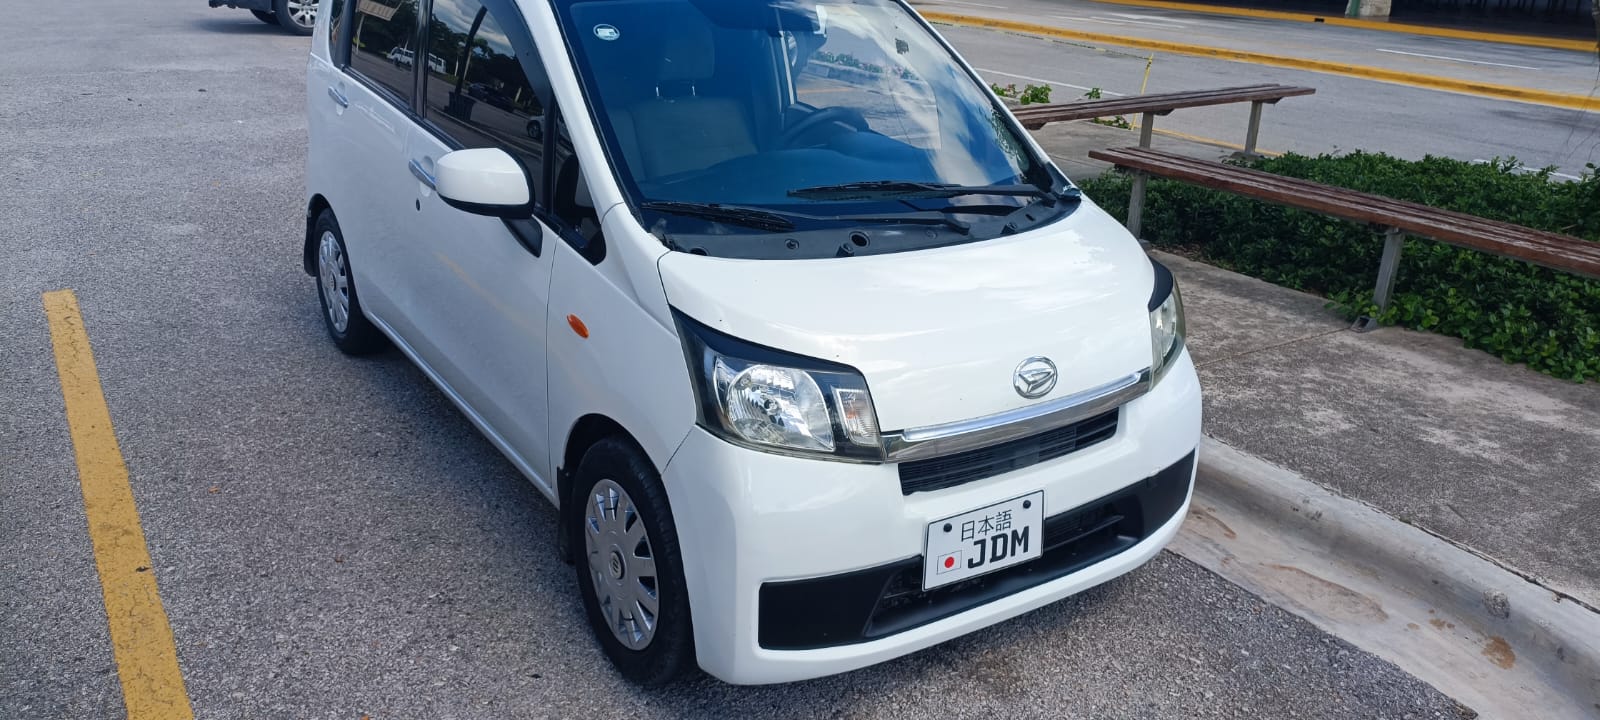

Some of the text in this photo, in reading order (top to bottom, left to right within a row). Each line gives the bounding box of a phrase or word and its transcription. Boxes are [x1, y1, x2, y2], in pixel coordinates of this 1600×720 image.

[961, 509, 1012, 542] 日本語
[967, 525, 1030, 569] JDM
